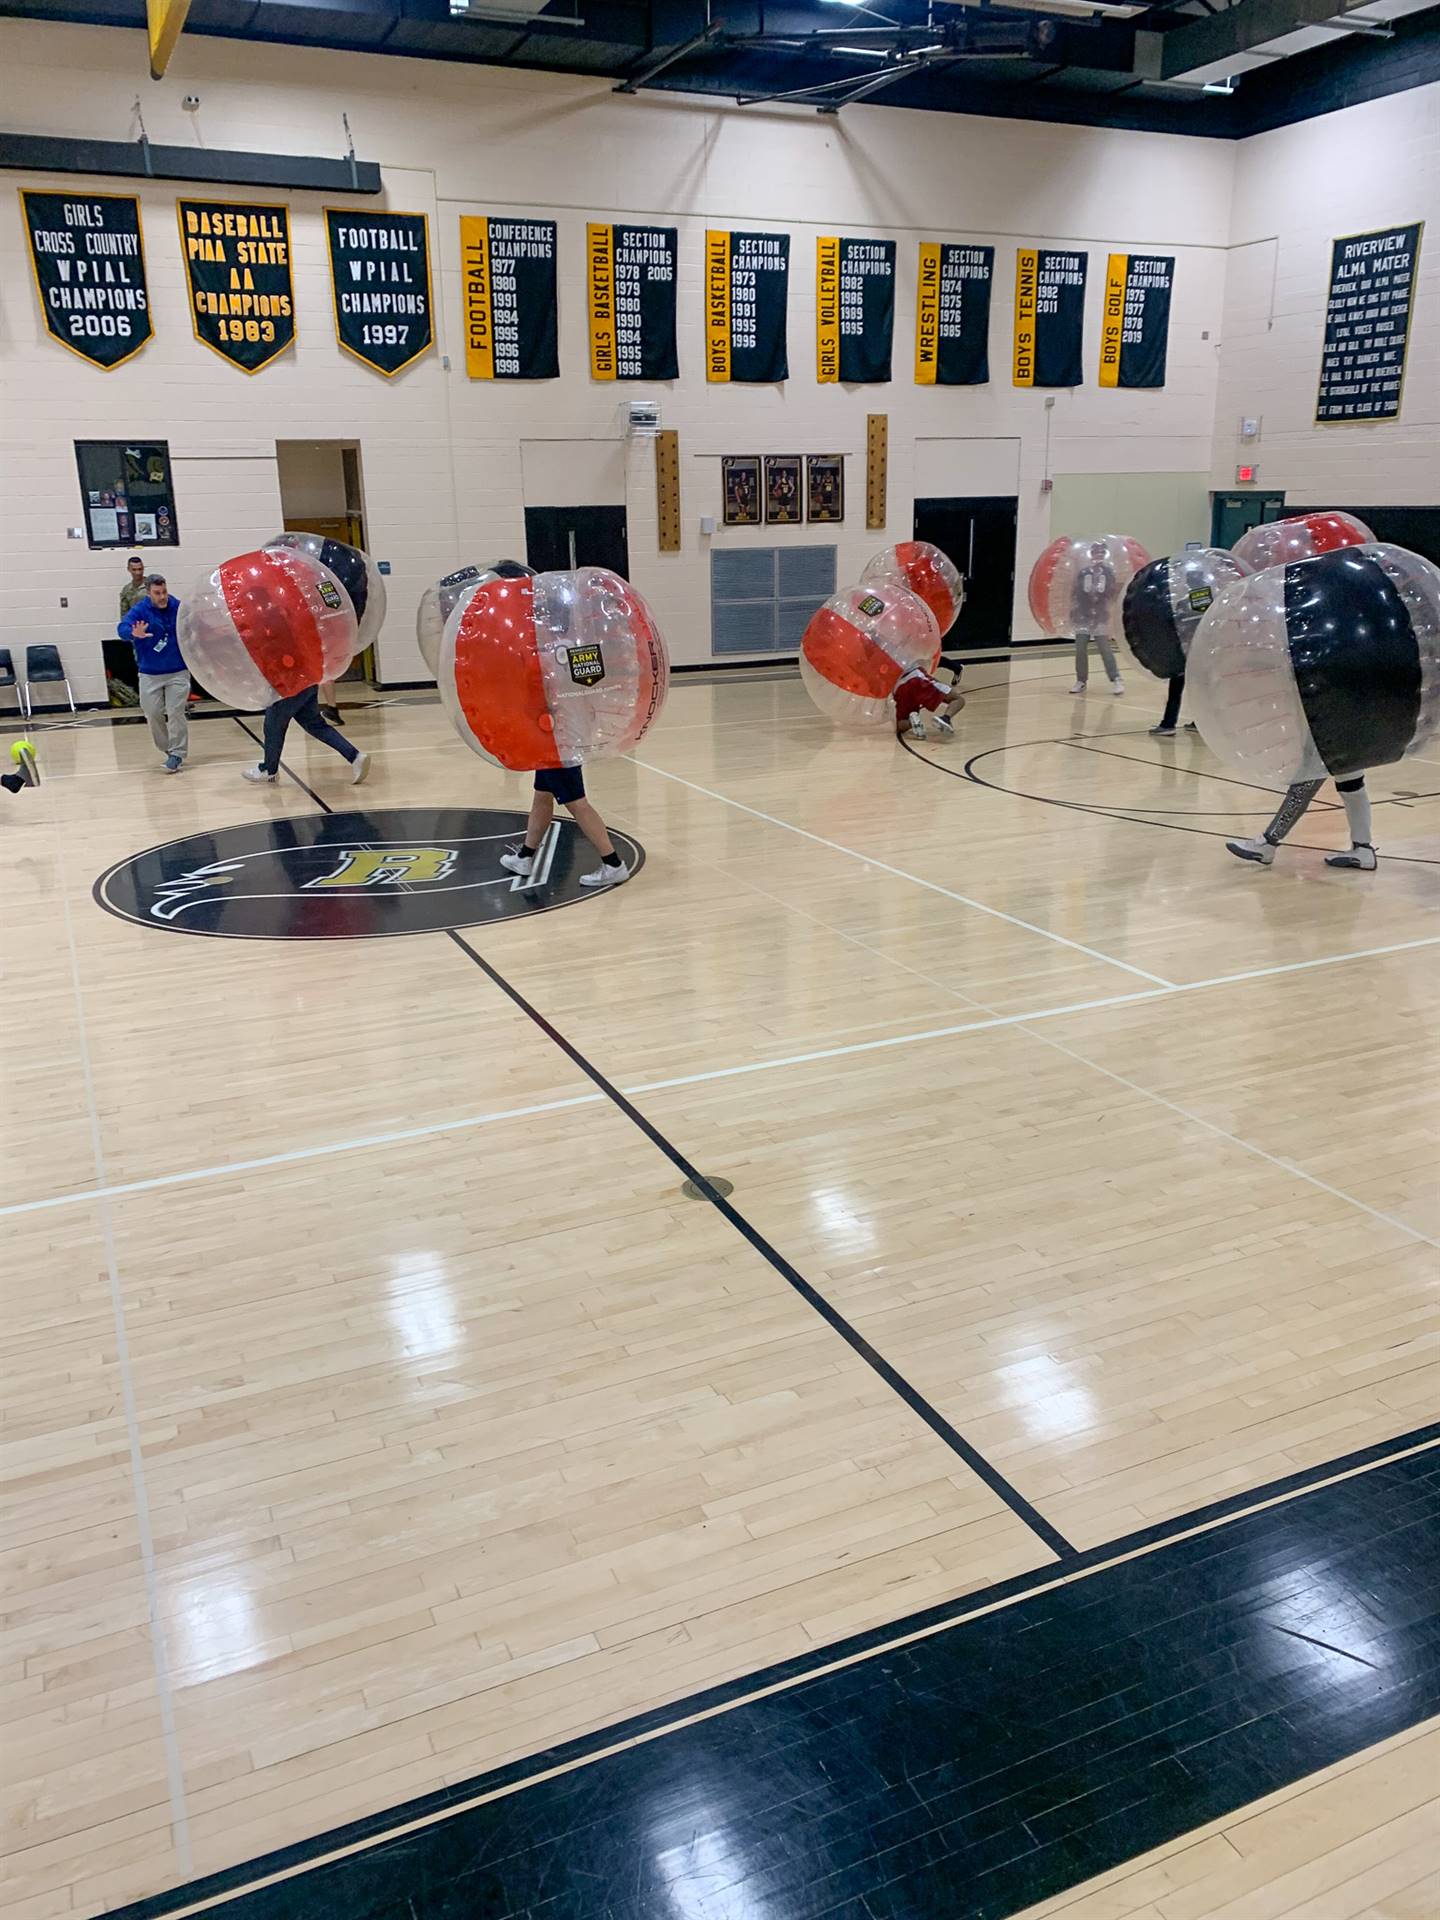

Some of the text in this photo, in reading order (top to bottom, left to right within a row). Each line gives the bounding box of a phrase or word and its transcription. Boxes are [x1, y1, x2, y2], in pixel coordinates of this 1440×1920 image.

[63, 203, 104, 227] GIRLS
[186, 210, 284, 238] BASEBALL
[338, 227, 418, 251] FOOTBALL
[488, 223, 554, 242] CONFERENCE
[622, 232, 666, 249] SECTION
[34, 230, 138, 256] CROSS COUNTRY
[187, 237, 288, 264] PIAA STATE
[491, 240, 552, 258] CHAMPIONS
[739, 239, 780, 255] SECTION
[1344, 234, 1407, 259] RIVERVIEW
[616, 247, 672, 265] CHAMPIONS
[847, 245, 886, 260] SECTION
[948, 249, 985, 264] SECTION
[491, 258, 516, 274] 1977
[732, 255, 786, 271] CHAMPIONS
[841, 260, 892, 276] CHAMPIONS
[1044, 256, 1080, 271] SECTION
[1134, 260, 1167, 275] SECTION
[1336, 253, 1410, 280] ALMA MATER
[230, 267, 255, 290] AA
[615, 265, 673, 281] 1978 2005
[731, 271, 756, 286] 1973
[942, 264, 990, 280] CHAMPIONS
[1039, 270, 1083, 285] CHAMPIONS
[492, 275, 516, 291] 1980
[615, 281, 641, 296] 1979
[840, 276, 864, 290] 1982
[941, 280, 962, 293] 1974
[1127, 274, 1170, 289] CHAMPIONS
[48, 287, 147, 310] CHAMPIONS
[466, 239, 488, 350] FOOTBALL
[492, 292, 517, 308] 1991
[592, 228, 612, 372] GIRLS BASKETBALL
[731, 287, 756, 301] 1980
[840, 291, 864, 305] 1986
[940, 294, 962, 308] 1975
[1126, 288, 1146, 302] 1976
[195, 291, 291, 317] CHAMPIONS
[341, 292, 425, 314] CHAMPIONS
[616, 297, 641, 312] 1980
[711, 240, 726, 373] BOYS BASKETBALL
[731, 303, 756, 317] 1981
[821, 242, 836, 375] GIRLS VOLLEYBALL
[920, 257, 937, 363] WRESTLING
[1036, 300, 1058, 313] 2011
[1124, 302, 1144, 316] 1977
[493, 309, 519, 325] 1994
[616, 313, 642, 328] 1990
[840, 306, 864, 320] 1989
[940, 309, 961, 323] 1976
[1017, 256, 1034, 379] BOYS TENNIS
[1103, 278, 1122, 364] BOYS GOLF
[69, 315, 132, 337] 2006
[218, 319, 275, 342] 1983
[731, 318, 756, 333] 1995
[840, 321, 864, 335] 1995
[939, 324, 961, 337] 1985
[1123, 317, 1143, 330] 1978
[362, 324, 409, 345] 1997
[494, 326, 518, 341] 1995
[616, 329, 642, 344] 1994
[731, 334, 756, 348] 1996
[1122, 330, 1142, 344] 2019
[494, 342, 519, 358] 1996
[617, 345, 642, 360] 1995
[495, 359, 520, 374] 1998
[617, 361, 642, 376] 1996
[572, 652, 598, 664] ARMY
[573, 660, 600, 668] NATIONAL
[573, 665, 602, 676] GUARD
[300, 847, 459, 889] R
